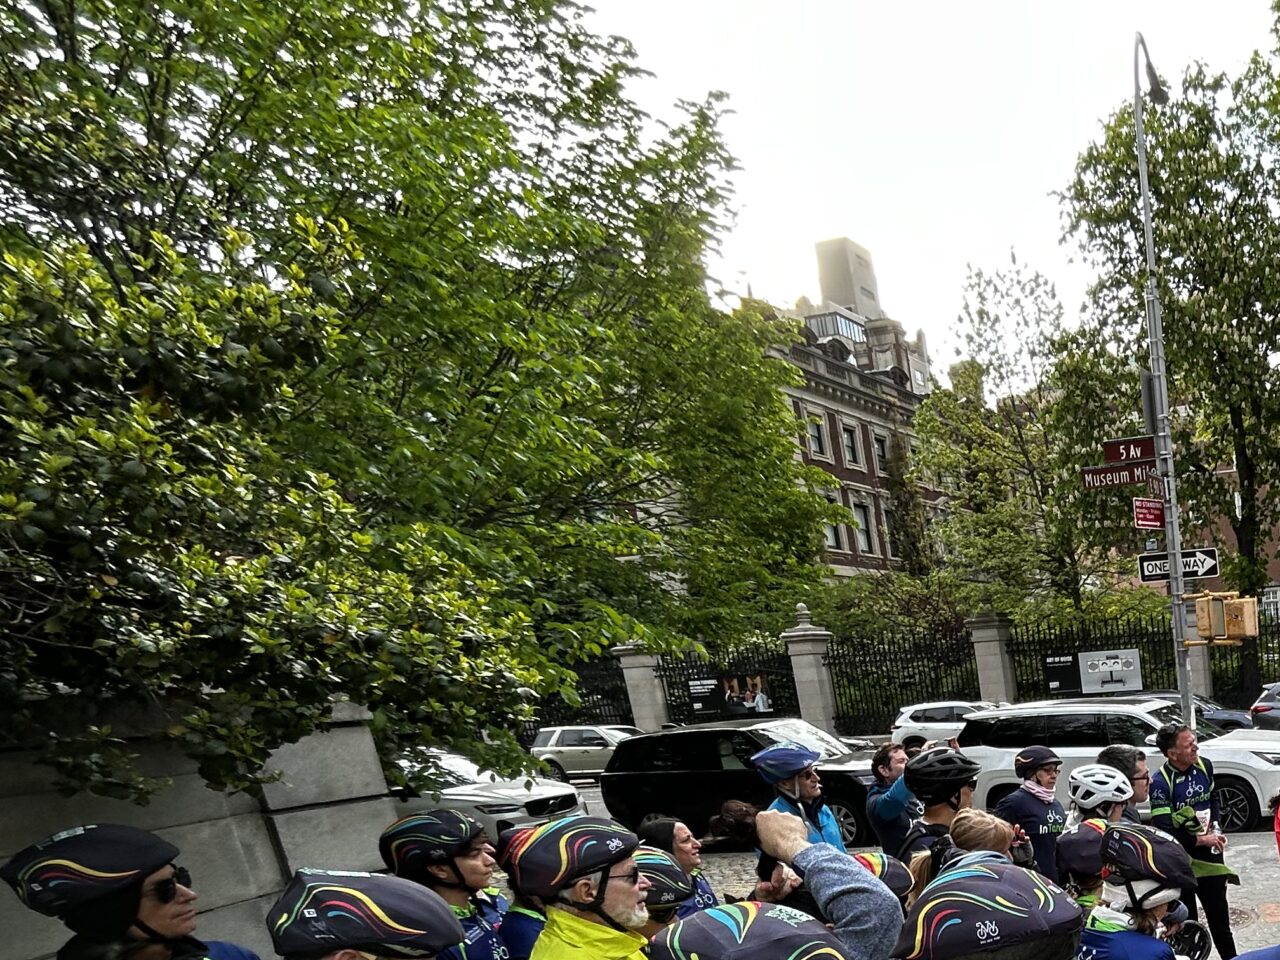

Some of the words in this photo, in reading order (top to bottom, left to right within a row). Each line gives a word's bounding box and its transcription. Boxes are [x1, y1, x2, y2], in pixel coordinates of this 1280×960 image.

[1119, 445, 1126, 460] 5
[1130, 444, 1142, 459] Av
[1084, 470, 1130, 488] Museum
[1146, 562, 1169, 573] ONE
[1183, 558, 1207, 570] WAY
